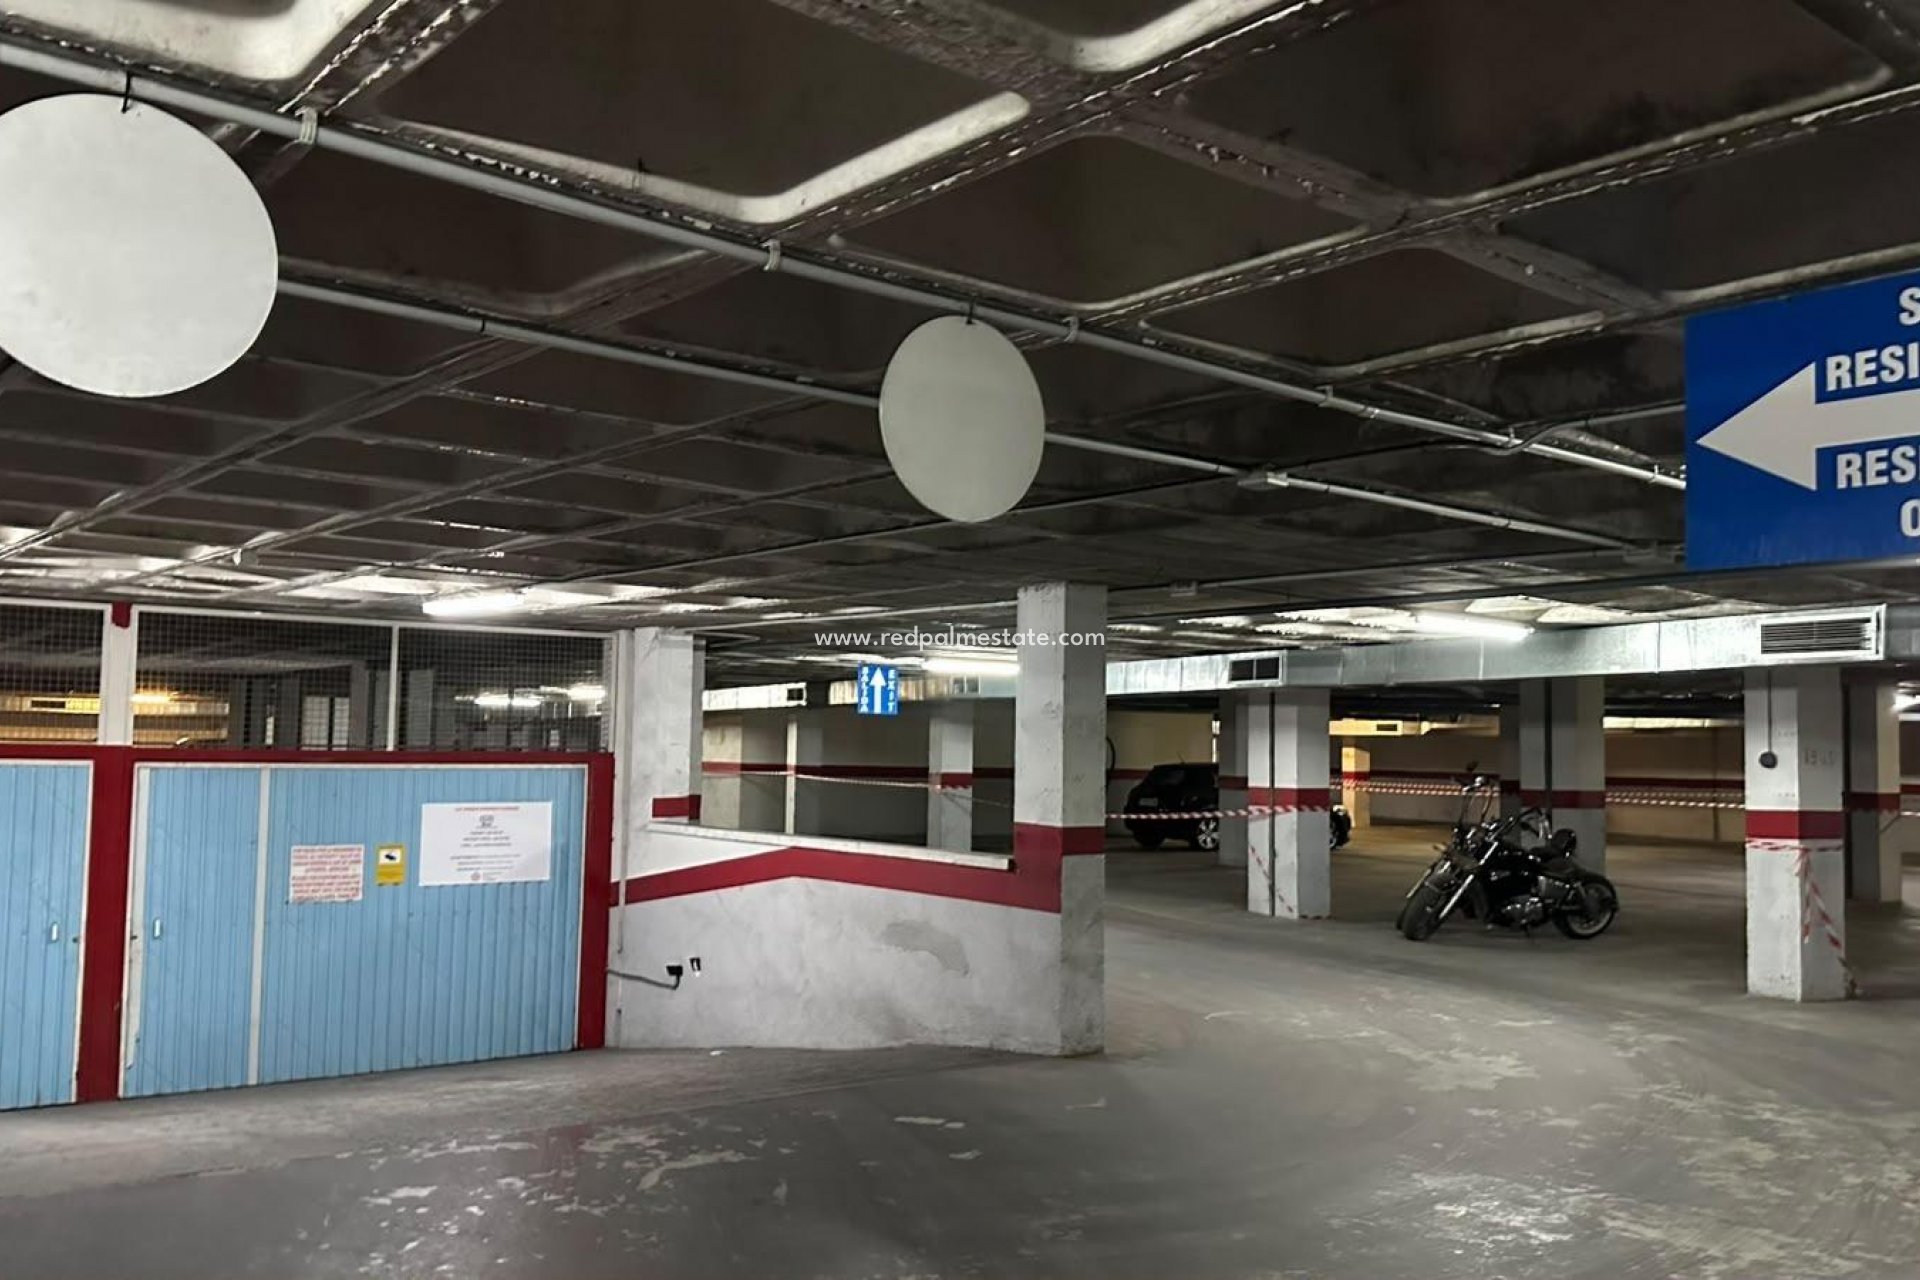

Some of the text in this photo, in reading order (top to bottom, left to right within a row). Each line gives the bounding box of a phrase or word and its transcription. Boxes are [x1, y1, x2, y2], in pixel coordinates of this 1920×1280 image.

[1836, 445, 1920, 490] RES
[860, 666, 870, 712] SALIDA
[887, 669, 896, 712] EXIT
